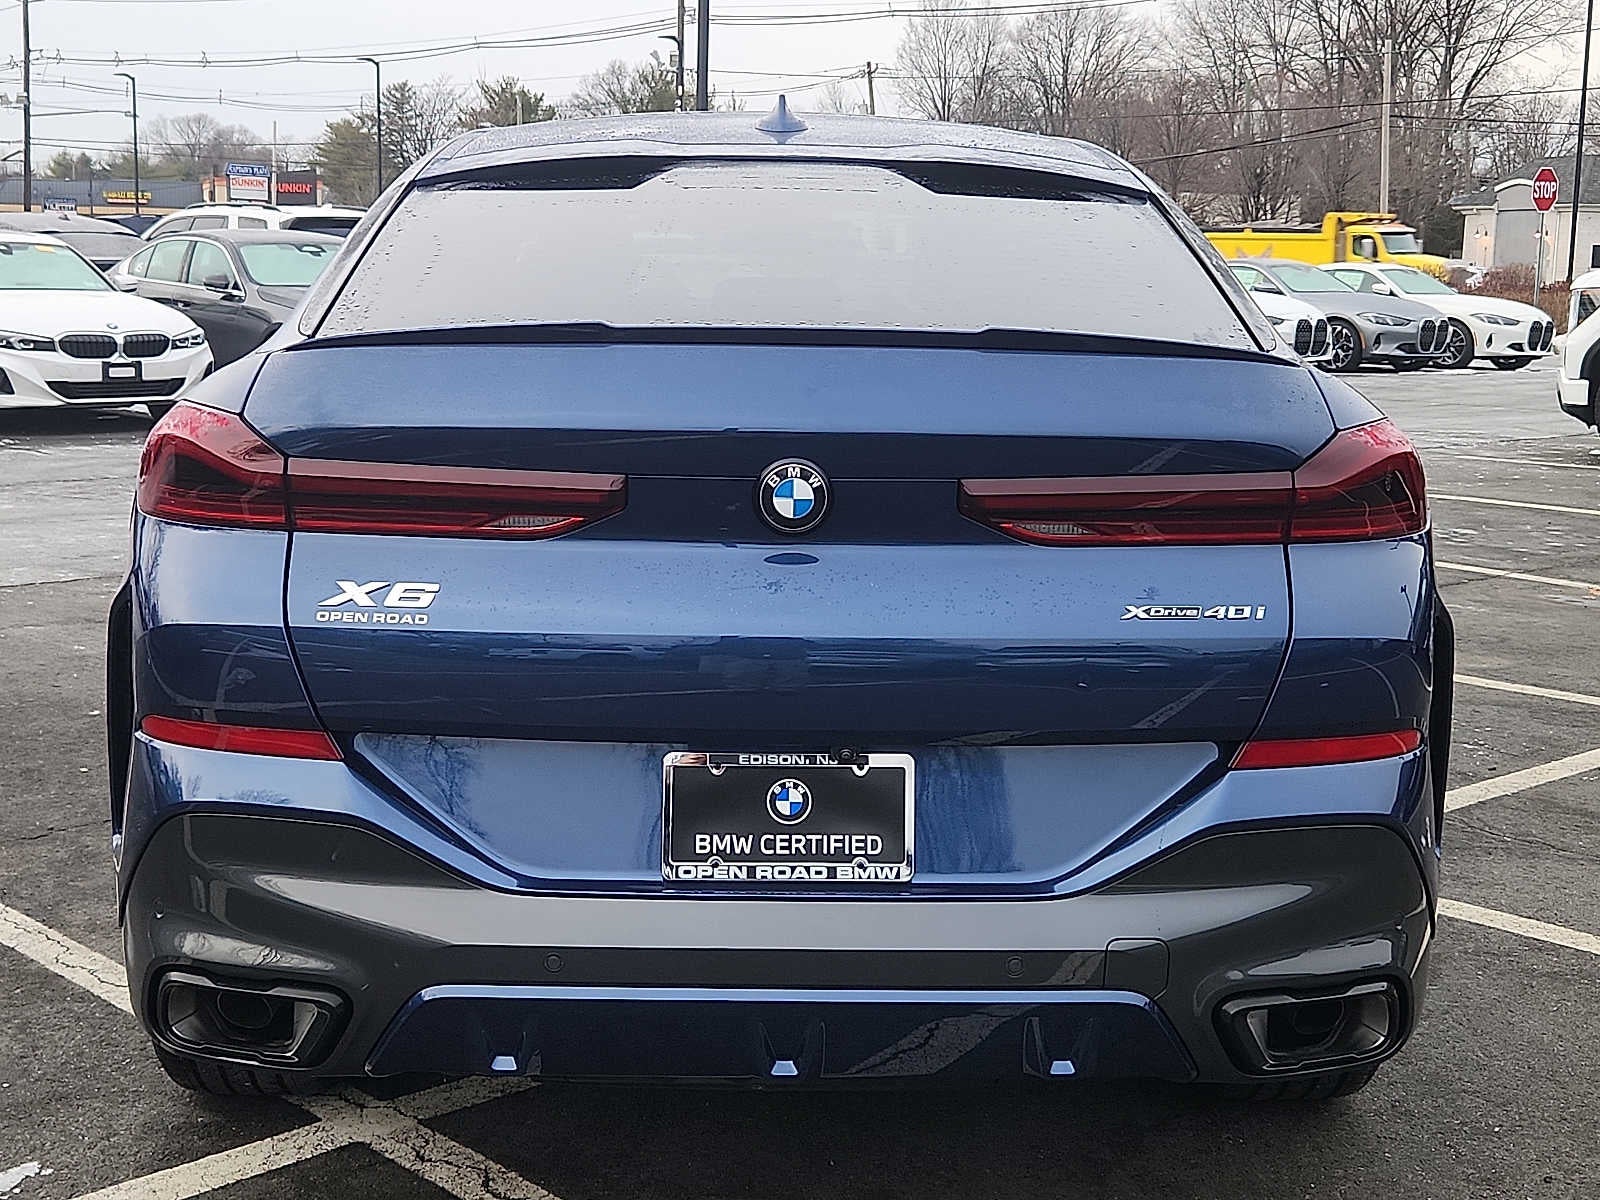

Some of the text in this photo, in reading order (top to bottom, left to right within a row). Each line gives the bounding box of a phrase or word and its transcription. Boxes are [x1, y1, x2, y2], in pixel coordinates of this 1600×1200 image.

[271, 182, 312, 193] UNKIN'
[1533, 181, 1556, 198] STOP
[767, 467, 822, 488] BMW
[317, 580, 440, 608] X6
[316, 611, 429, 625] OPEN ROAD
[739, 754, 810, 765] EDISON,
[773, 781, 806, 794] BMW
[695, 834, 883, 855] BMW CERTIFIED
[677, 865, 899, 880] OPEN ROAD BMW
